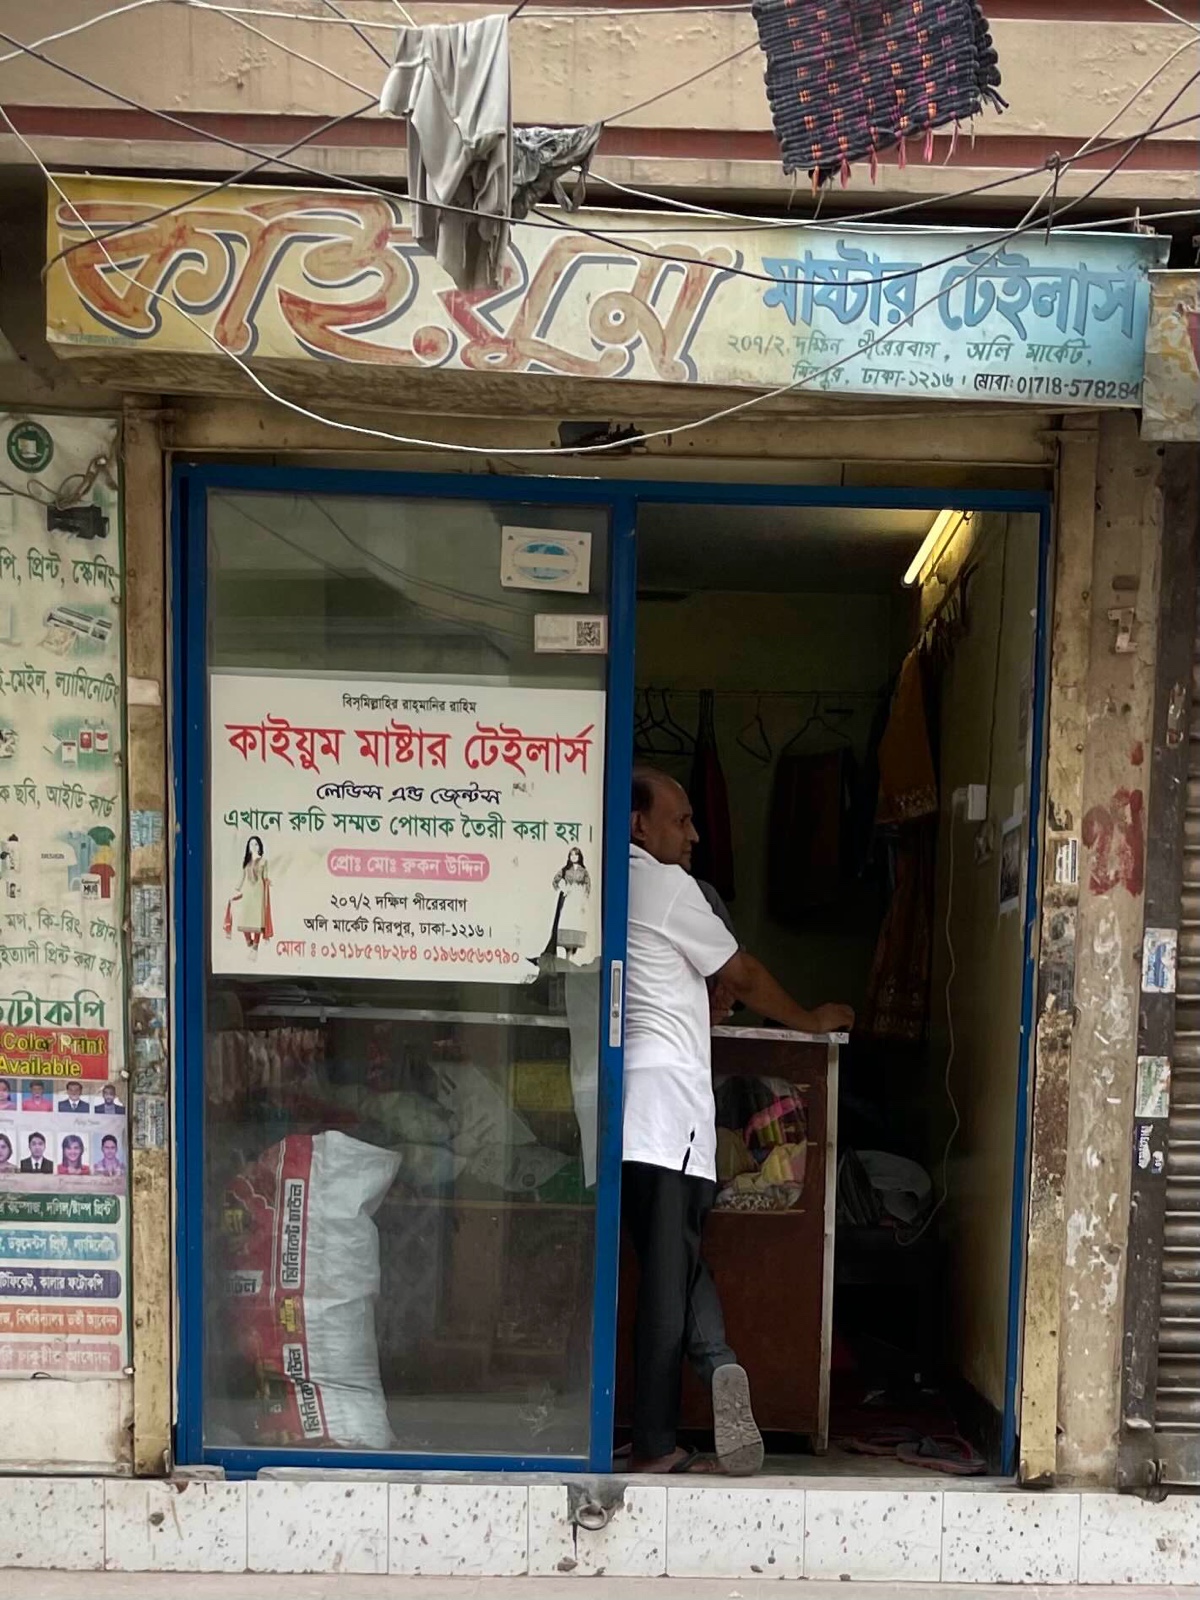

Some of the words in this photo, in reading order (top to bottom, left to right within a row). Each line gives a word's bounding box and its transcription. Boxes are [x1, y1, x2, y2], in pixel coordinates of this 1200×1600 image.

[966, 335, 1014, 363] অলি
[1016, 376, 1139, 399] 01718-578284
[449, 698, 477, 714] রাহিম
[224, 713, 346, 775] কাইয়ুম
[354, 718, 452, 769] মাষ্টার
[465, 721, 595, 777] টেইলার্স
[316, 780, 384, 800] লেডিস
[388, 786, 424, 803] এন্ড
[430, 782, 502, 809] জেন্টস
[224, 808, 283, 831] এখানে
[288, 805, 327, 832] রুচি
[331, 813, 383, 834] সম্মত
[390, 815, 455, 838] পোষাক
[460, 812, 506, 840] তৈরী
[511, 819, 549, 842] করা
[444, 854, 485, 877] উদ্দিন
[330, 893, 371, 910] ২০৭/২
[412, 892, 468, 912] পীরেরবাগ
[303, 914, 329, 931] অলি
[332, 916, 369, 933] মার্কেট
[373, 916, 414, 937] মিরপুর,
[74, 950, 96, 972] করা
[321, 942, 417, 961] ০১৭১৮৫৭৮২৮৪
[423, 946, 520, 964] ০১৯৬৩৫৬৩৭৯০
[0, 989, 106, 1028] টোকপি
[3, 1031, 53, 1054] Color
[59, 1033, 105, 1055] Print
[0, 1055, 81, 1077] Available
